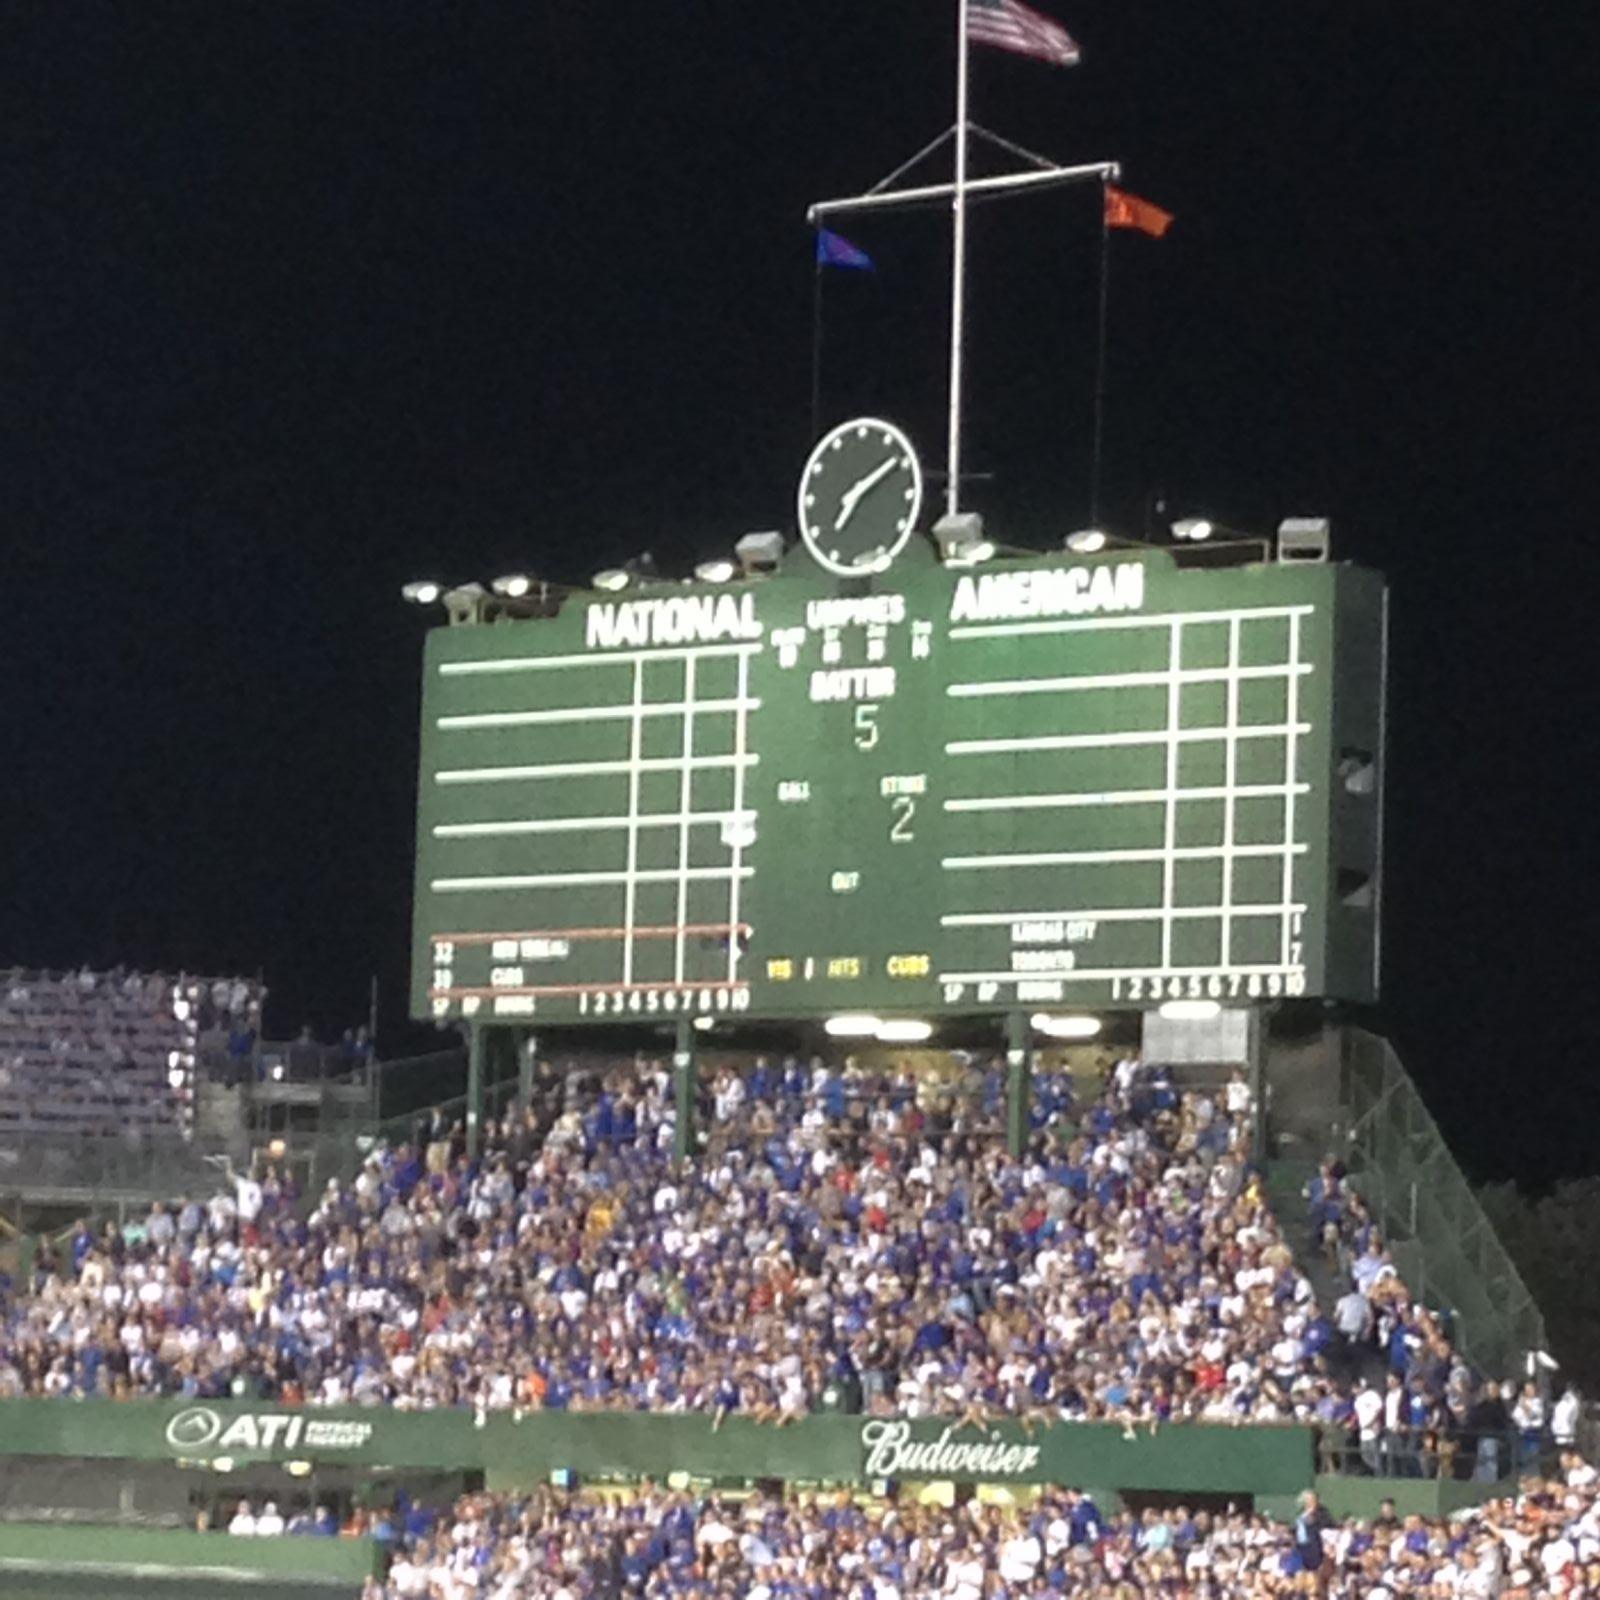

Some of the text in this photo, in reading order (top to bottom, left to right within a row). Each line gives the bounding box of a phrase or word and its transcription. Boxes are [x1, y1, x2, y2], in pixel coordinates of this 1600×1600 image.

[951, 563, 1145, 620] AMERICAN
[586, 594, 763, 647] NATIONAL
[855, 705, 878, 748] 5
[891, 796, 914, 841] 2
[219, 1415, 302, 1448] ATI
[863, 1421, 1040, 1476] Budweiser
